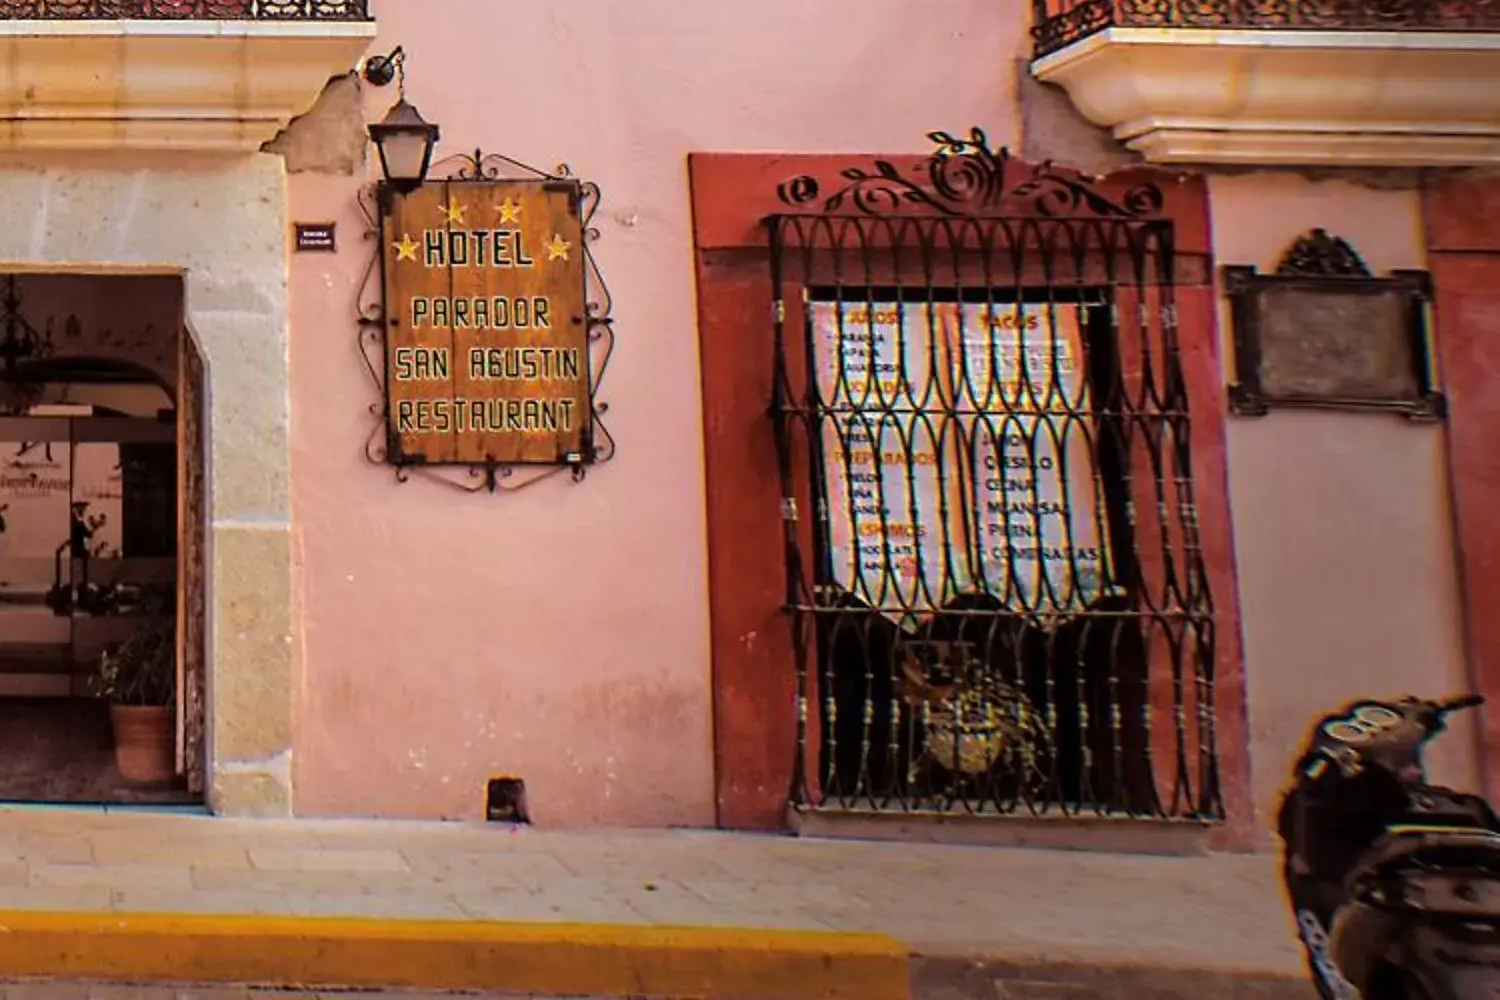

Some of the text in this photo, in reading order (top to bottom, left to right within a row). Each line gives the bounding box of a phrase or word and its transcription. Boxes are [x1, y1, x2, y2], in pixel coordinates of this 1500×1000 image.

[424, 229, 534, 267] HOTEL
[412, 297, 550, 329] PARADOR
[396, 347, 580, 381] SAN AGUSTIN
[397, 399, 575, 432] RESTAURANT
